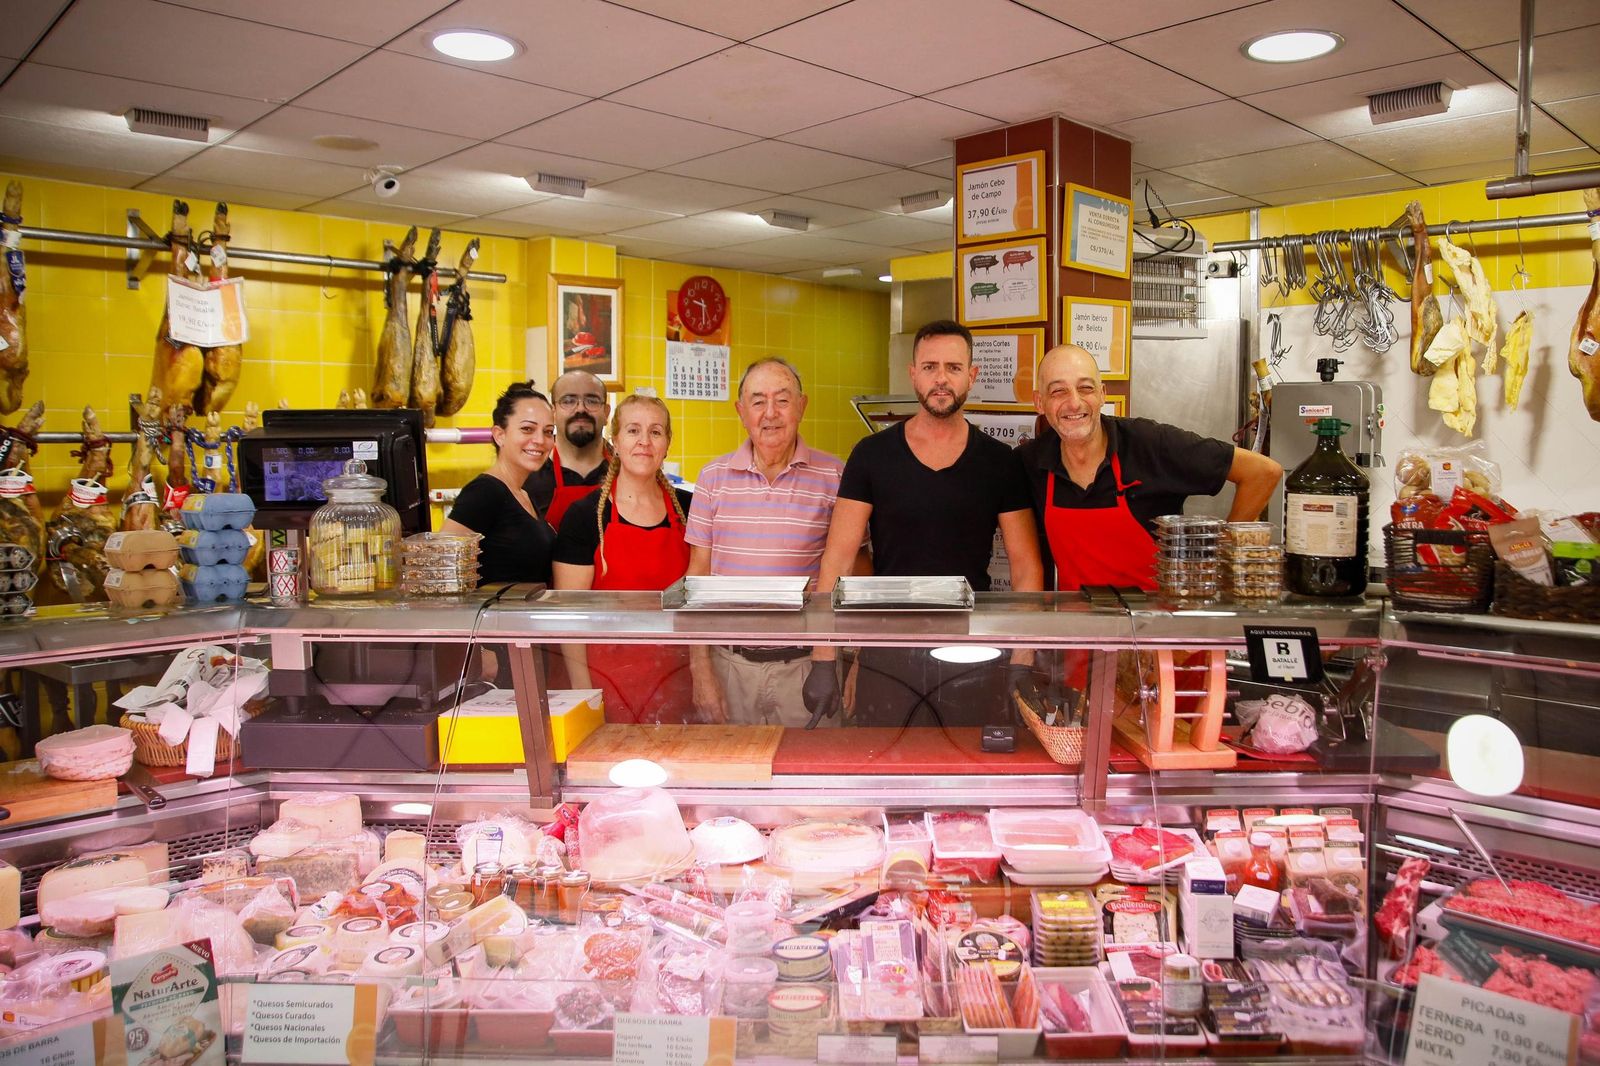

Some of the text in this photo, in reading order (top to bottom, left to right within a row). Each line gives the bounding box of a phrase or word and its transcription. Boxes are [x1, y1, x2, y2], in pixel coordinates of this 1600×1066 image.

[968, 179, 1006, 190] Jamón Cebo
[981, 190, 1002, 199] Campo
[968, 208, 989, 219] 37,90
[1112, 900, 1156, 910] Boquerones
[190, 943, 210, 958] NUEVO
[133, 978, 199, 1002] NaturArte
[285, 1000, 334, 1008] Semicurados
[1461, 997, 1528, 1026] PICADAS
[1419, 1004, 1484, 1034] TERNERA
[1494, 1028, 1532, 1049] 10,90
[1416, 1021, 1466, 1046] CERDO
[14, 1046, 27, 1054] DE
[29, 1036, 60, 1050] BARRA
[294, 1036, 340, 1045] Importación
